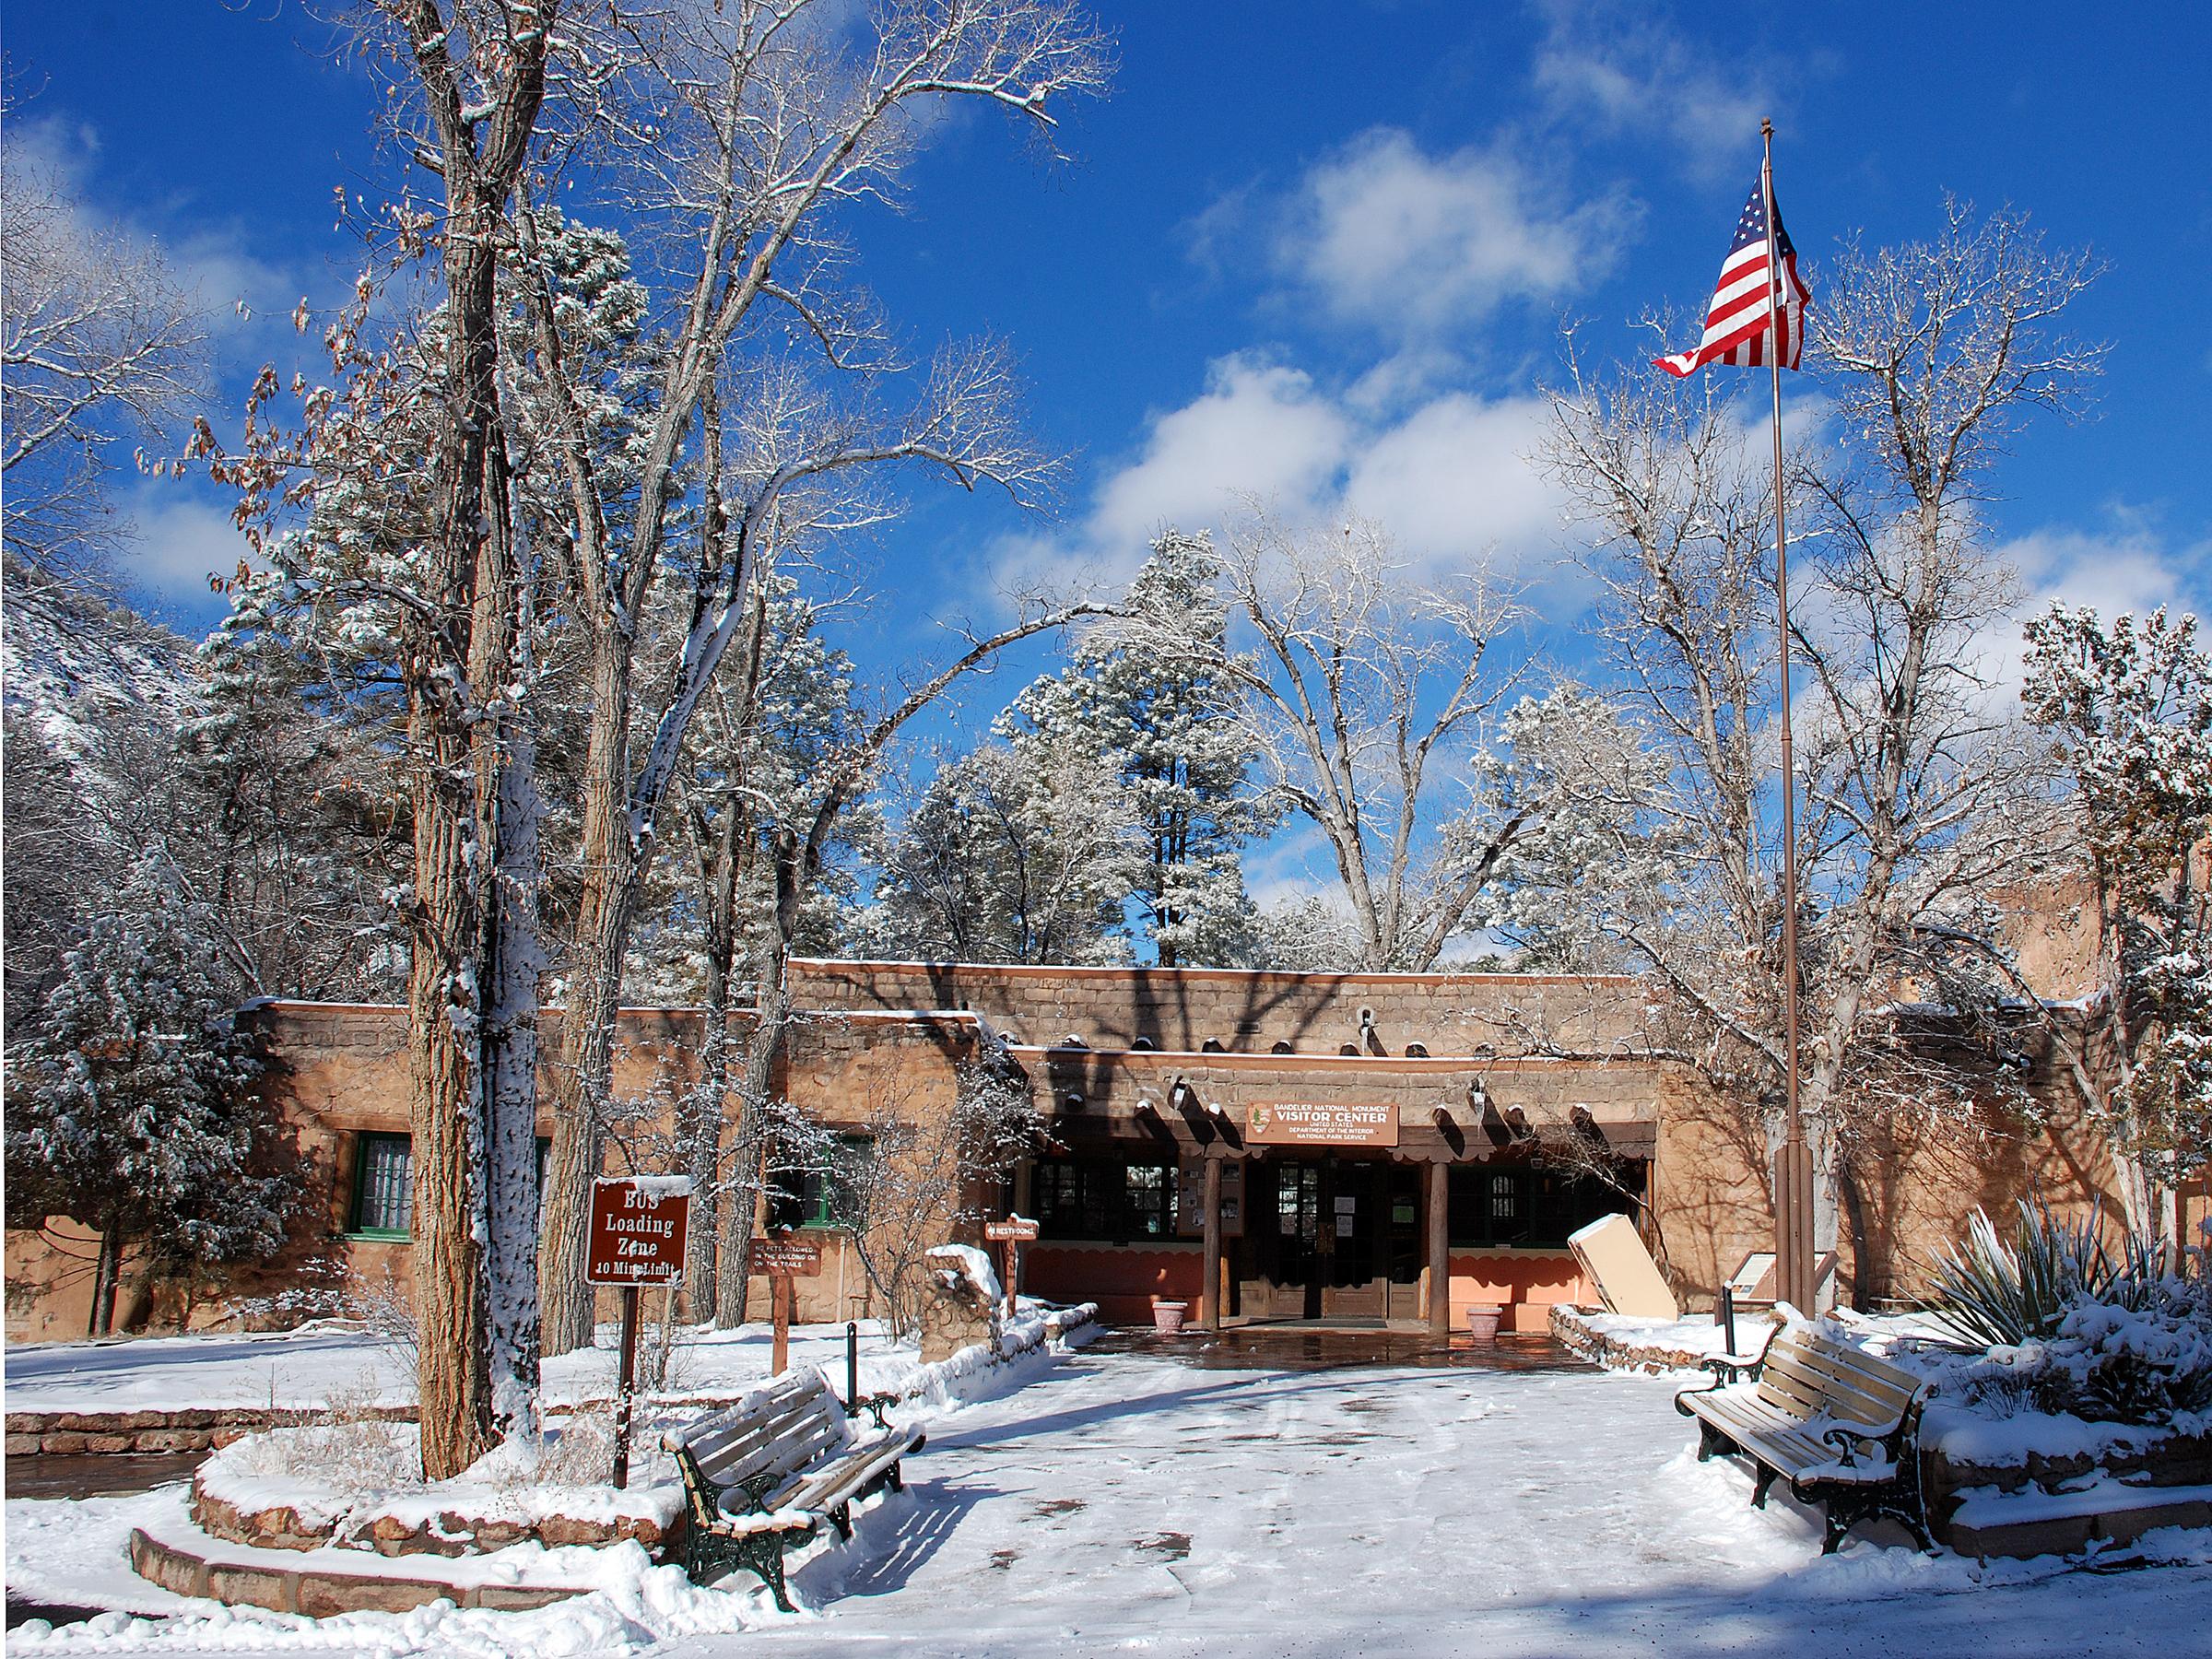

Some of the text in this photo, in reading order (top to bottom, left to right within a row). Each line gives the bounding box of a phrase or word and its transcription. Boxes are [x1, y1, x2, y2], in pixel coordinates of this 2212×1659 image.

[1277, 1112, 1330, 1122] VISITOR
[1335, 1112, 1387, 1123] CENTER
[606, 1213, 675, 1238] Loading
[595, 1262, 610, 1274] 10
[643, 1261, 675, 1276] Limit
